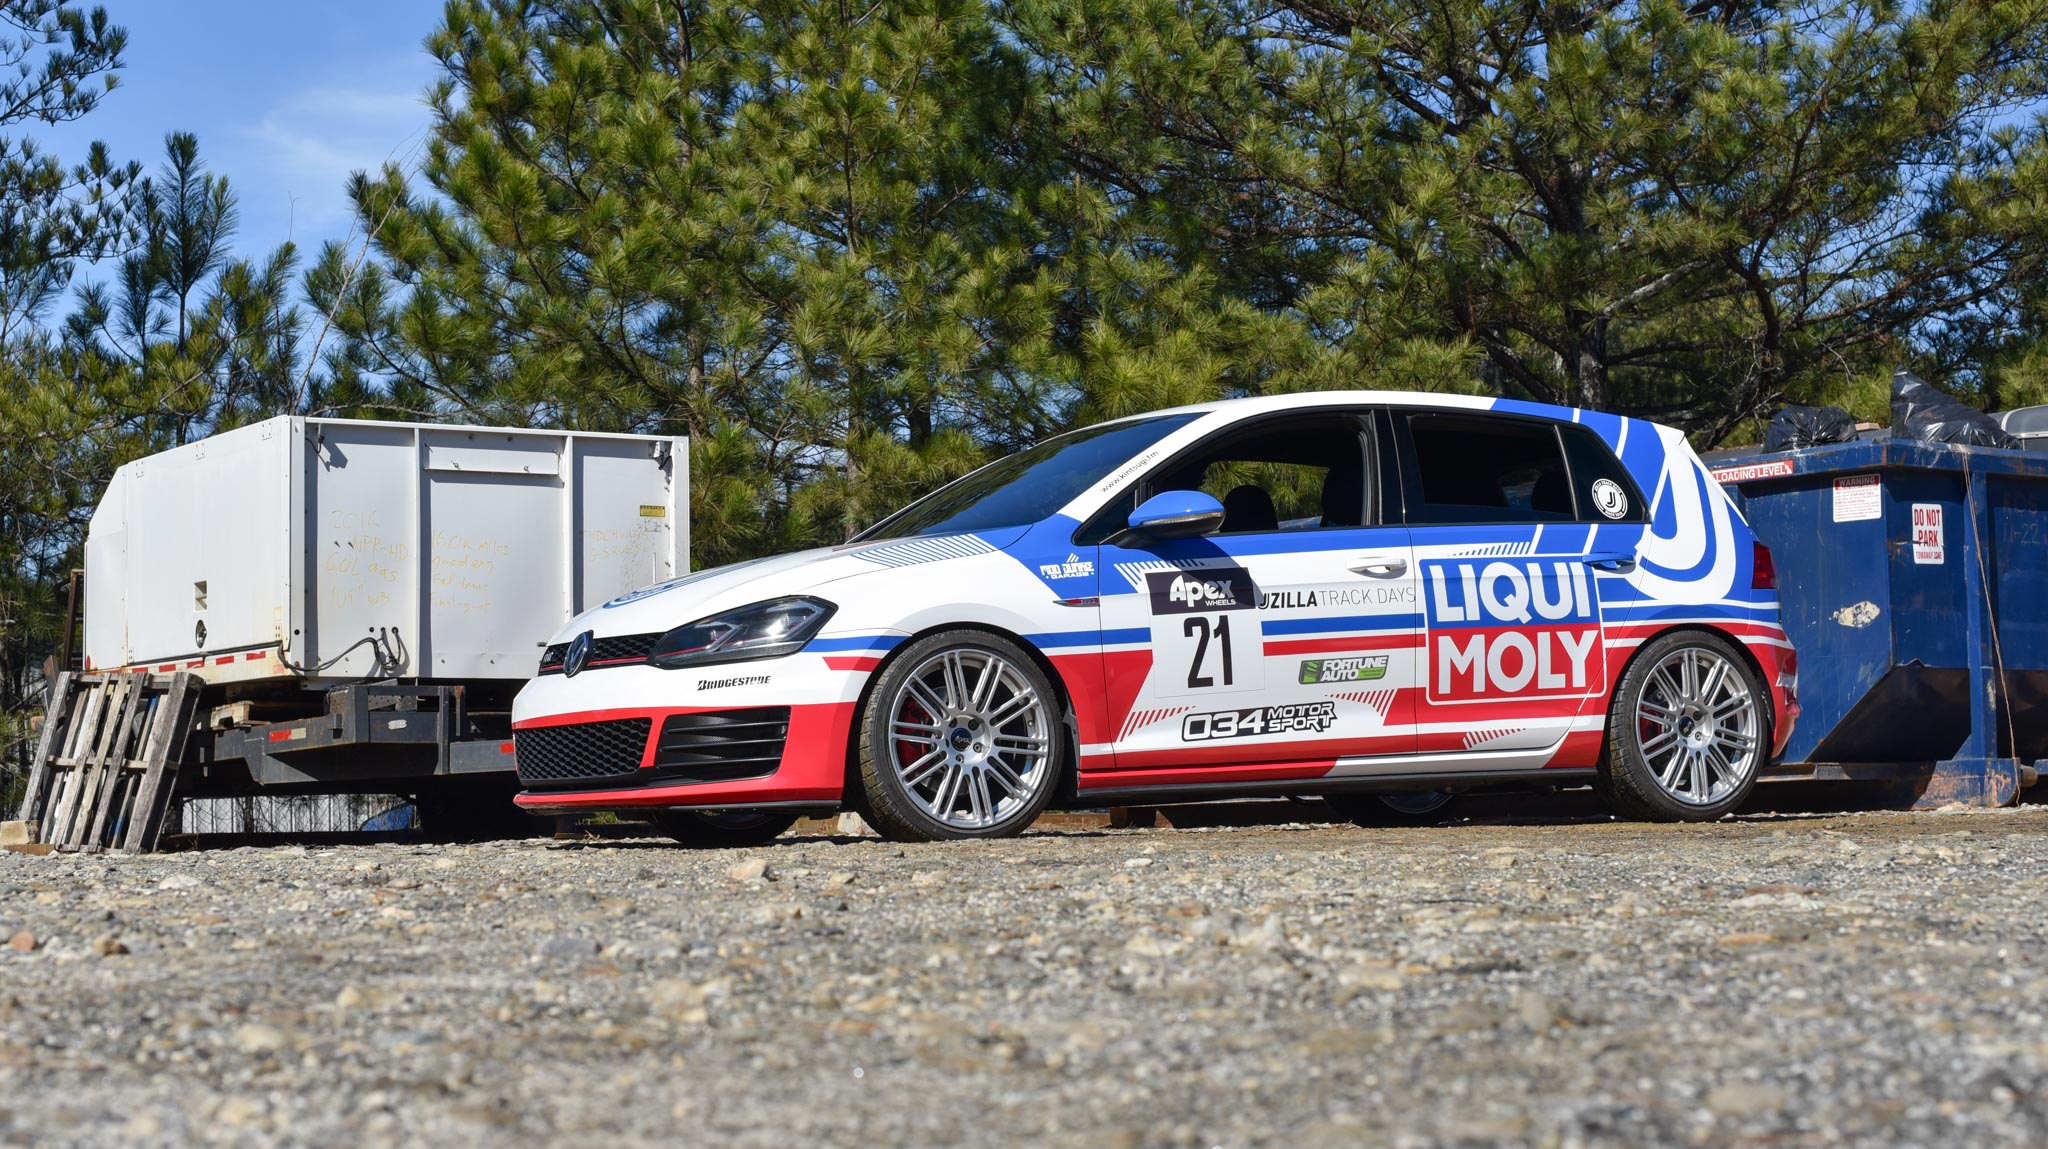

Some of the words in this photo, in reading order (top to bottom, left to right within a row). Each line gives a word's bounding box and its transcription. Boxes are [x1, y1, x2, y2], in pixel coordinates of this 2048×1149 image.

[1716, 469, 1755, 482] LOADING
[1757, 465, 1786, 478] LEVEL
[1838, 476, 1875, 487] WARNING
[1914, 508, 1924, 526] DO
[1926, 509, 1940, 526] NOT
[1918, 529, 1939, 547] PARK
[1169, 574, 1235, 607] Apex
[1319, 588, 1373, 606] TRACK
[1377, 586, 1416, 604] DAYS
[1428, 561, 1592, 625] LIQUI
[1205, 598, 1236, 607] WHEELS
[1183, 615, 1233, 689] 21
[1322, 656, 1388, 671] FORTUNE
[1437, 629, 1599, 695] MOLY
[697, 675, 771, 691] BRIDGESTONE
[1320, 669, 1359, 681] AUTO
[1183, 708, 1265, 741] 034
[1267, 702, 1335, 720] MOTOR
[1268, 715, 1332, 732] SPORT
